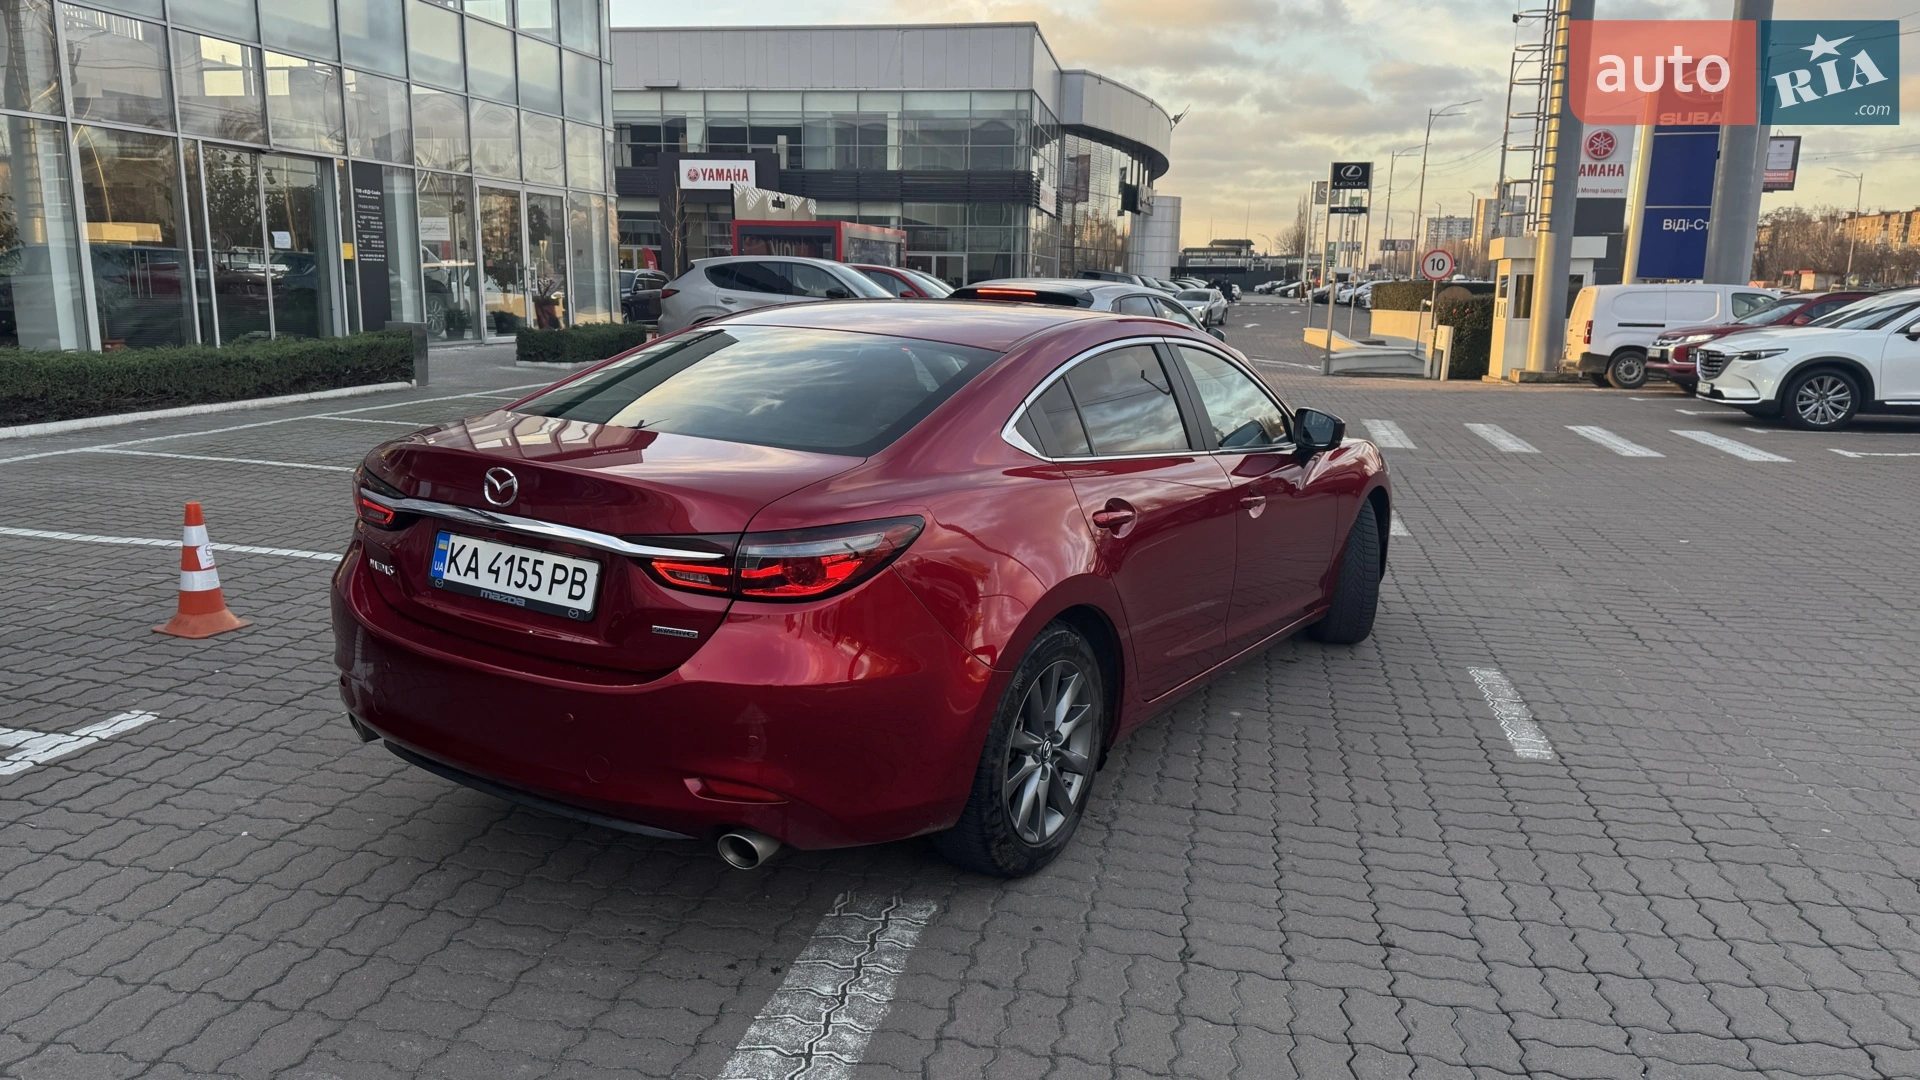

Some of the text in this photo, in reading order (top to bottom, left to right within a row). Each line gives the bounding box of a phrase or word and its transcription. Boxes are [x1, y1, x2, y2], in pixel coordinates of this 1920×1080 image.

[701, 168, 749, 182] YAMAHA
[1430, 258, 1446, 271] 10
[434, 560, 444, 572] UA
[446, 542, 588, 601] KA 4155 PB
[480, 589, 526, 607] mazda
